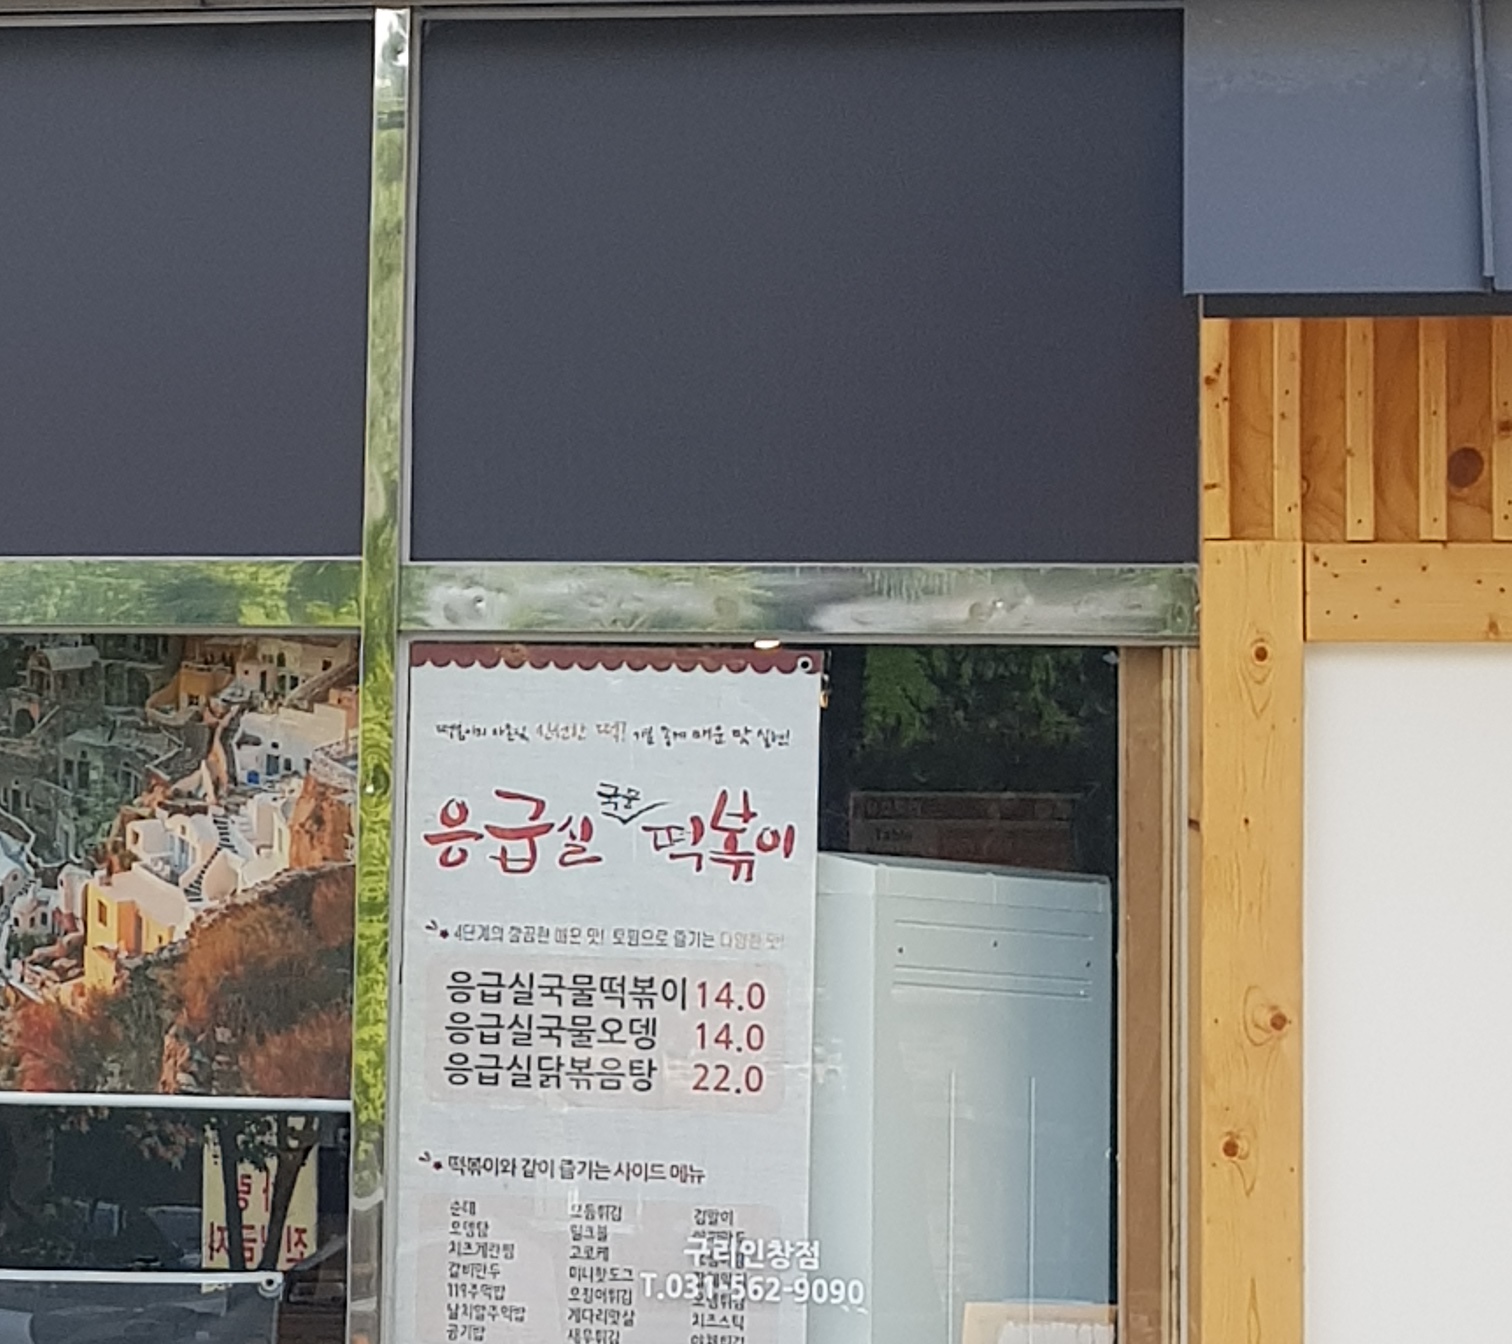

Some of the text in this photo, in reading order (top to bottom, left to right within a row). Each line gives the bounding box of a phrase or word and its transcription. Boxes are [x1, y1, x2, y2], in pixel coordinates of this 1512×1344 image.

[423, 788, 797, 883] 응급실 떡볶이
[445, 970, 766, 1011] 응급실국물떡볶이 14.0
[444, 1011, 766, 1052] 응급실국물오뎅 14.0
[443, 1053, 764, 1094] 응급실닭볶음탕 22.0
[448, 1155, 706, 1185] 떡볶이와 같이 즐기는 사이드 메뉴
[684, 1238, 820, 1270] 구리인창점
[639, 1271, 865, 1305] T.031-562-9090
